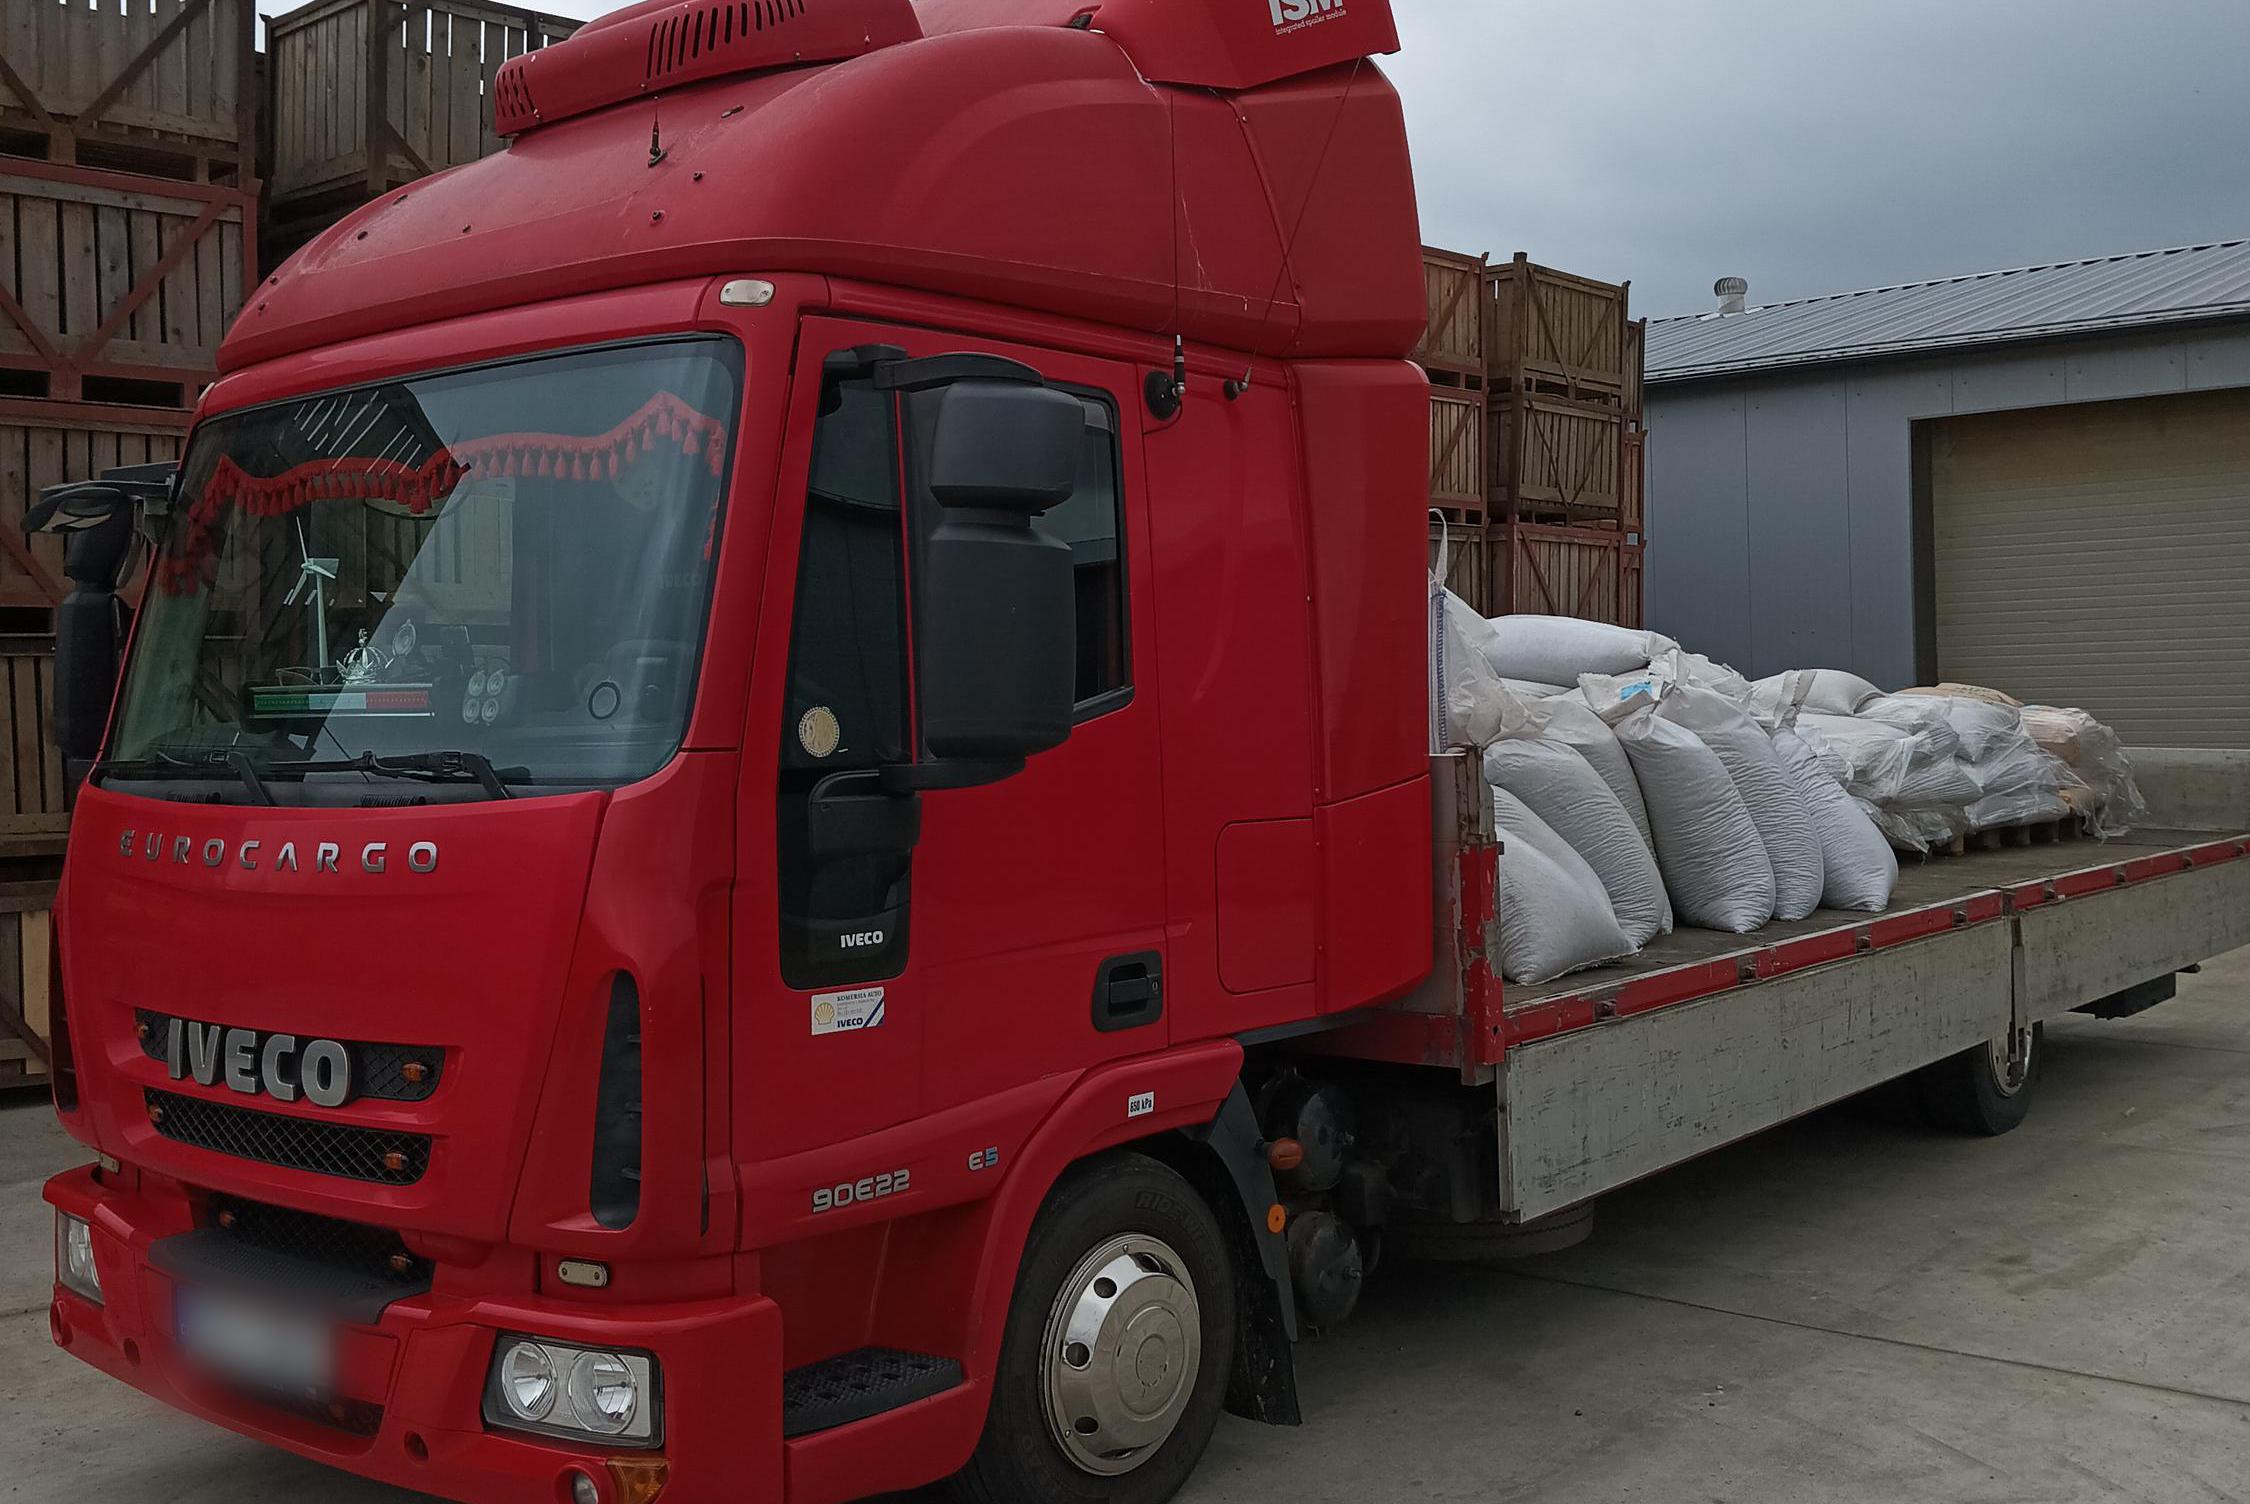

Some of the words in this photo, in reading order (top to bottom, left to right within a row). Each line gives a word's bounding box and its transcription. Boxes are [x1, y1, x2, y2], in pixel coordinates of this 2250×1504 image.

[1267, 0, 1344, 26] IS
[119, 830, 439, 873] EUROCARGO
[840, 930, 884, 948] IVECO
[837, 1017, 864, 1028] IVECO
[168, 1018, 352, 1107] IVECO
[968, 1146, 998, 1171] E5
[812, 1169, 910, 1213] 90E22
